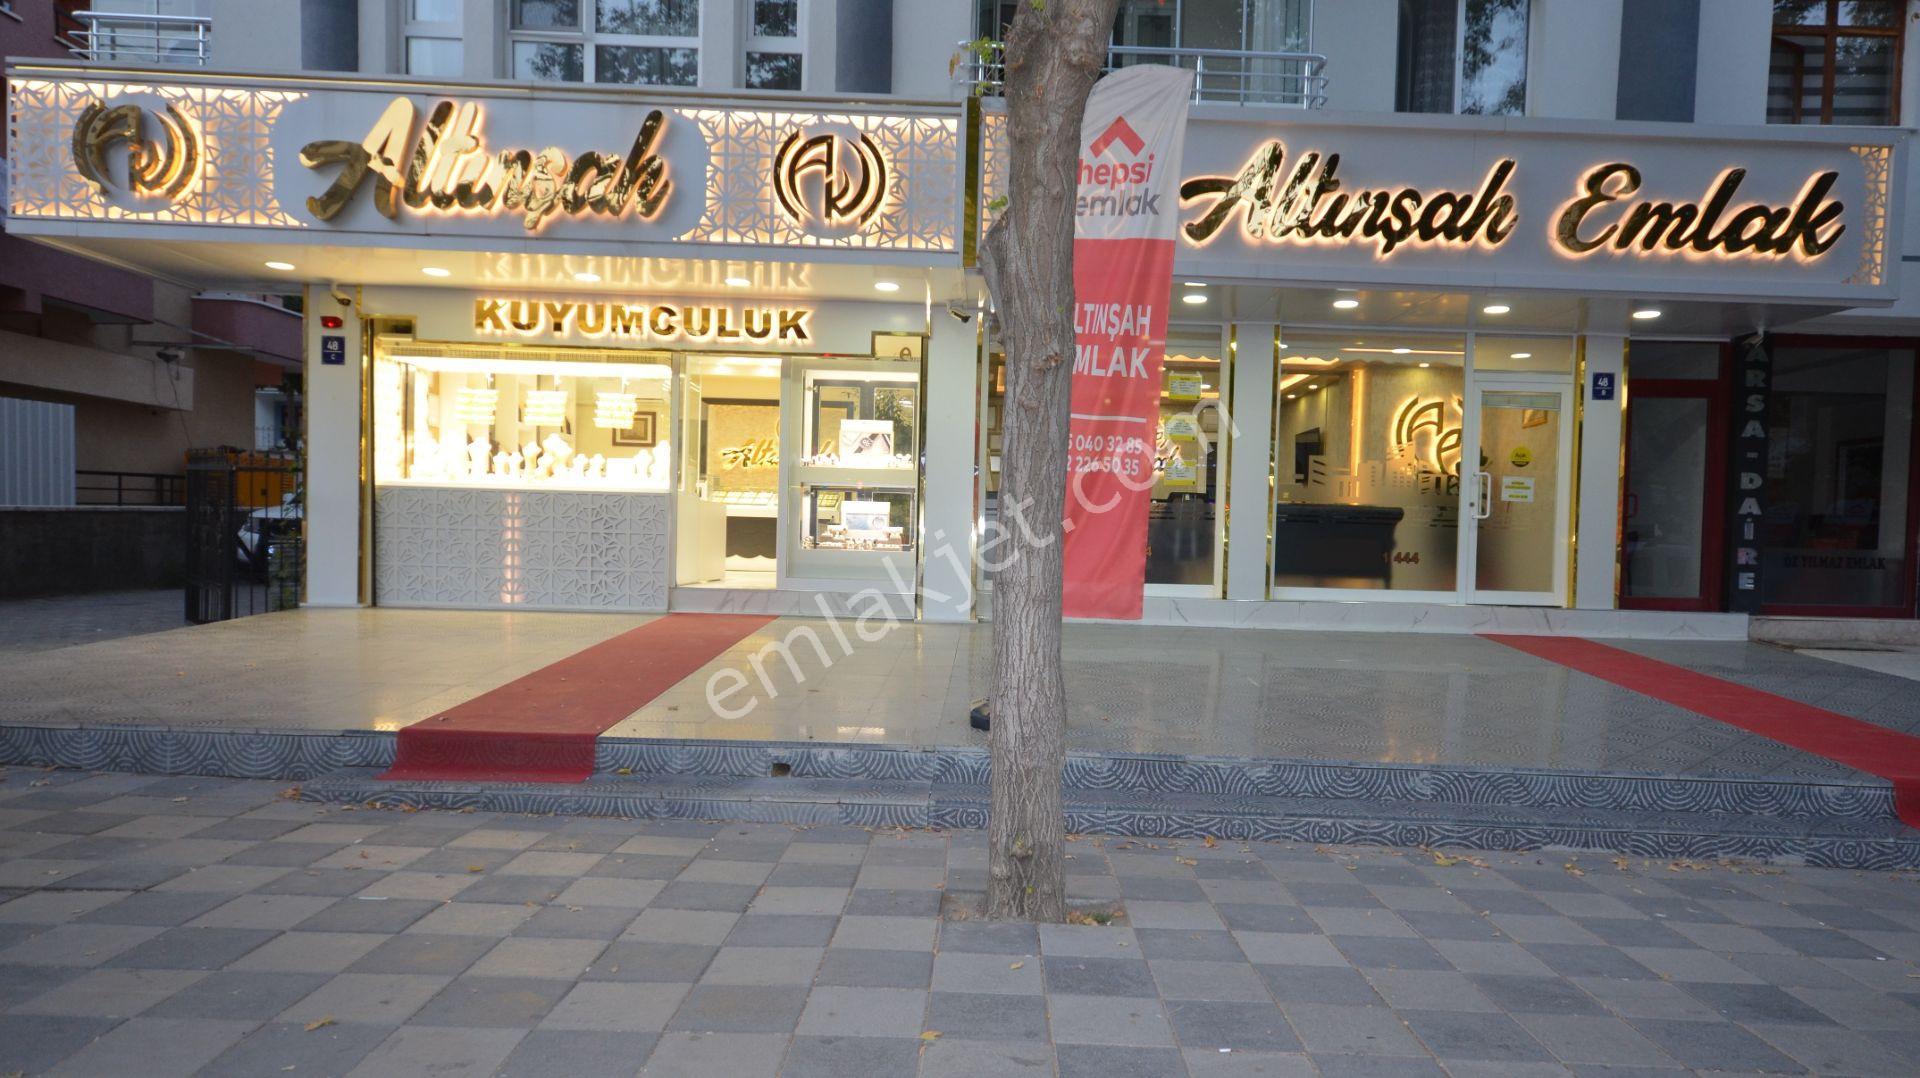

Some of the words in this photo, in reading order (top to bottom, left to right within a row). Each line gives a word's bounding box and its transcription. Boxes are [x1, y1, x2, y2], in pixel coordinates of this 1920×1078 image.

[299, 97, 674, 231] Altınşah
[1077, 154, 1154, 190] hepsi
[1074, 188, 1160, 216] emlak
[1181, 141, 1519, 255] Altınşah
[1556, 163, 1846, 257] Emlak
[475, 299, 811, 339] KUYUMCULUK
[1074, 303, 1152, 342] LTINŞAH
[327, 340, 339, 351] 48
[1072, 345, 1150, 379] MLAK
[1598, 377, 1609, 387] 48
[1075, 434, 1104, 452] 040
[1106, 435, 1123, 453] 32
[1126, 437, 1143, 454] 85
[1103, 456, 1121, 473] 50
[1124, 458, 1140, 475] 35
[1846, 557, 1886, 570] EMLAK
